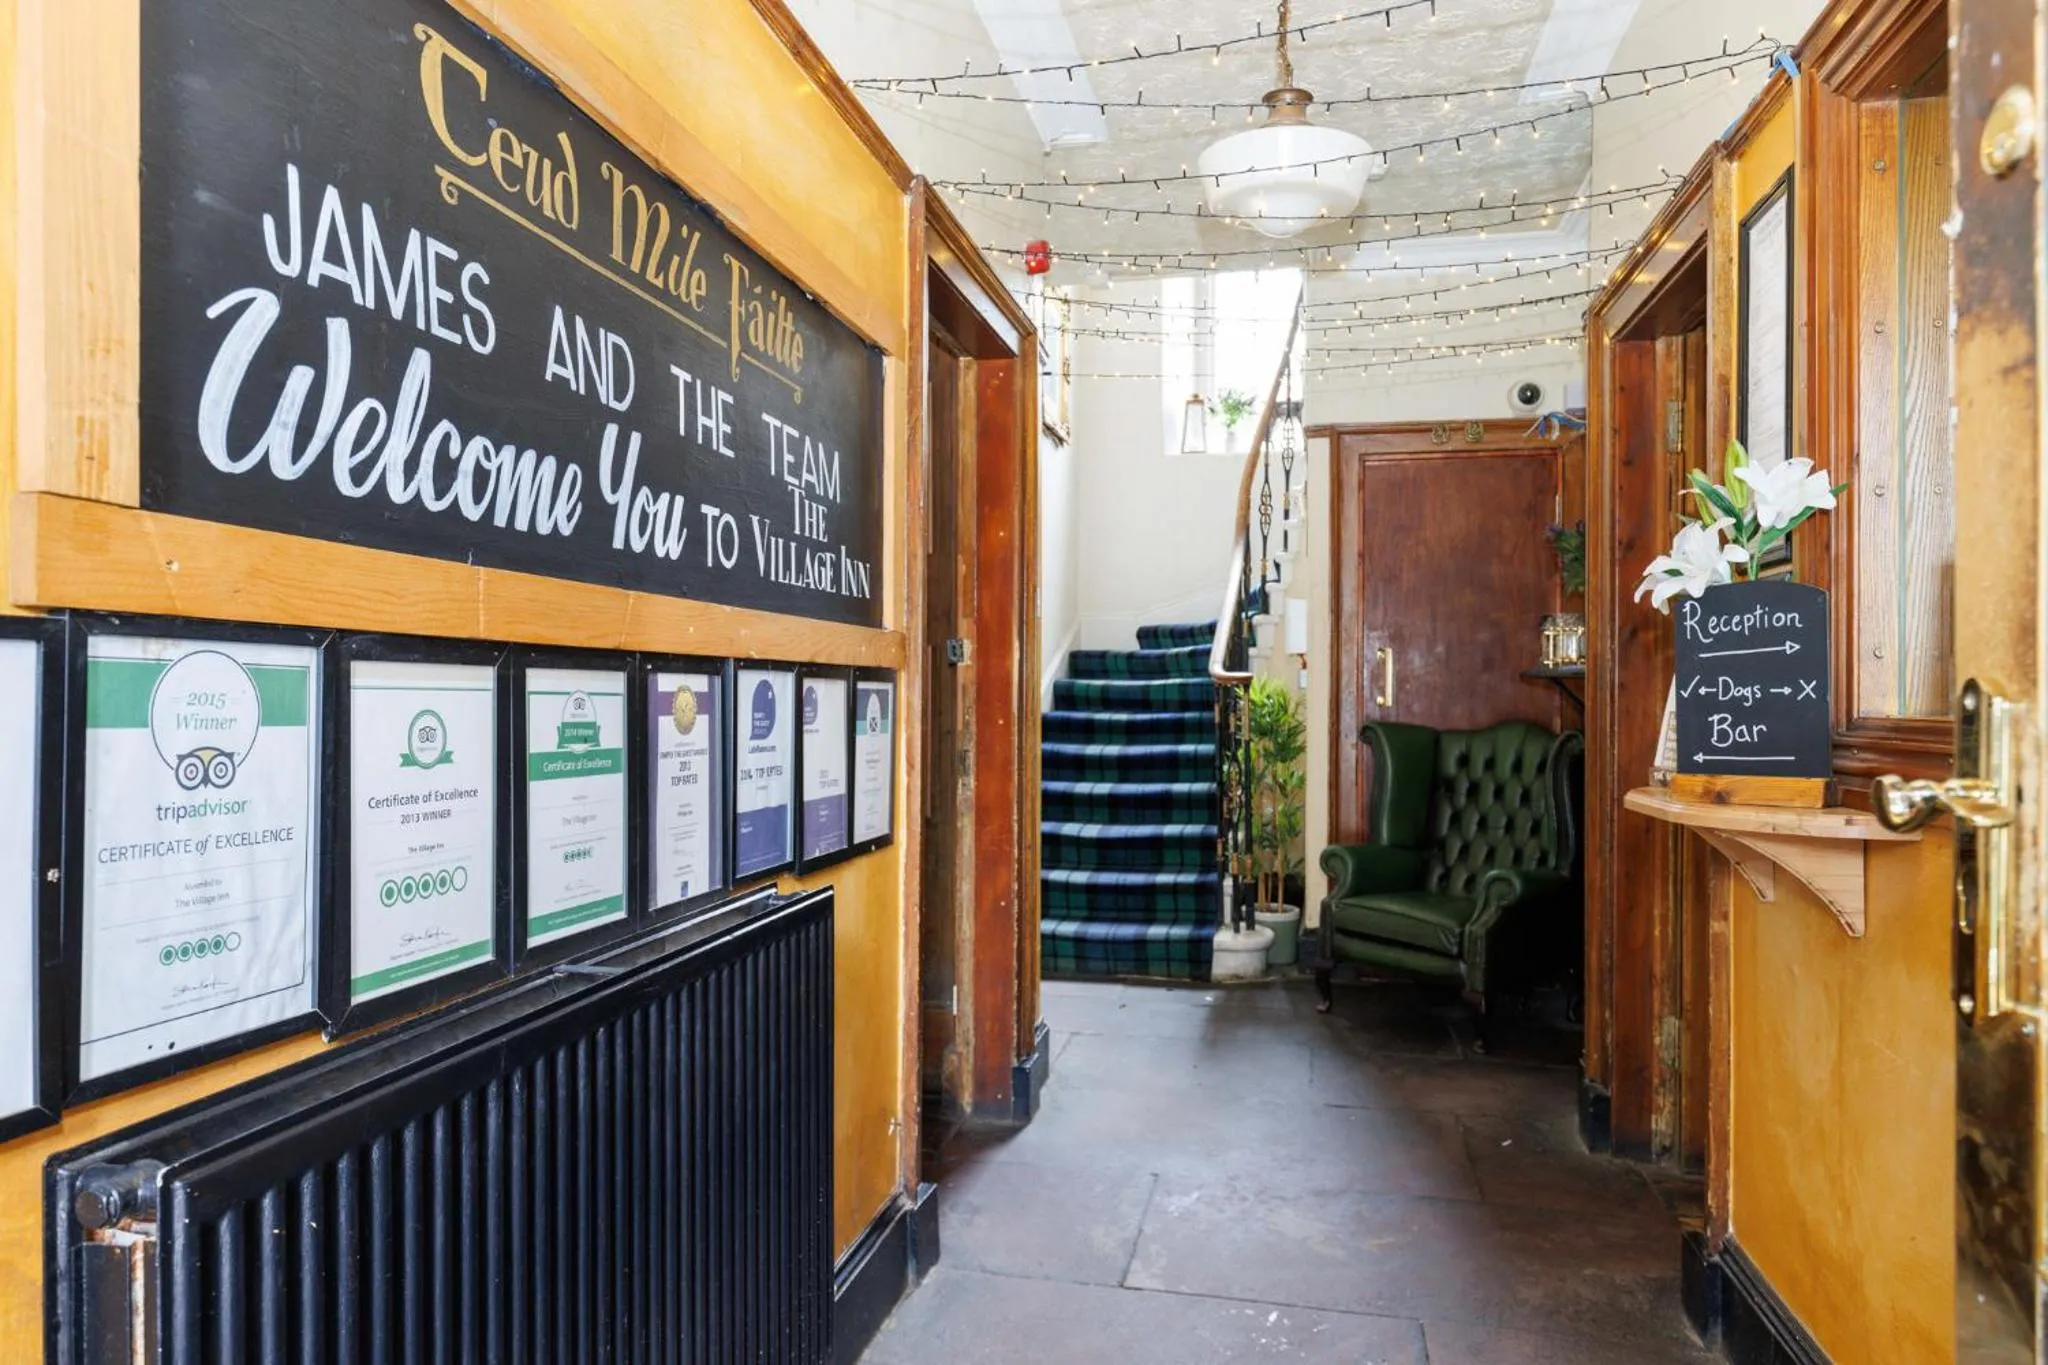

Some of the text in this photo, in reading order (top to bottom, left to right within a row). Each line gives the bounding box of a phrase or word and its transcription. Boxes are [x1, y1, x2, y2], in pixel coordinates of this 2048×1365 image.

[262, 162, 841, 504] JAMES AND THE TEAM
[197, 287, 740, 570] Welcome You TO
[1682, 600, 1804, 644] Reception
[186, 691, 229, 710] 2015
[1717, 676, 1762, 707] Dogs
[176, 713, 238, 732] Winner
[1707, 712, 1768, 748] Bar
[543, 760, 576, 773] Certificate
[156, 798, 248, 824] tripadvisor
[368, 787, 480, 810] Certificate of Excellence
[400, 809, 453, 825] 2013 WINNER
[98, 826, 295, 864] CERTIFICATE of EXCELLENCE
